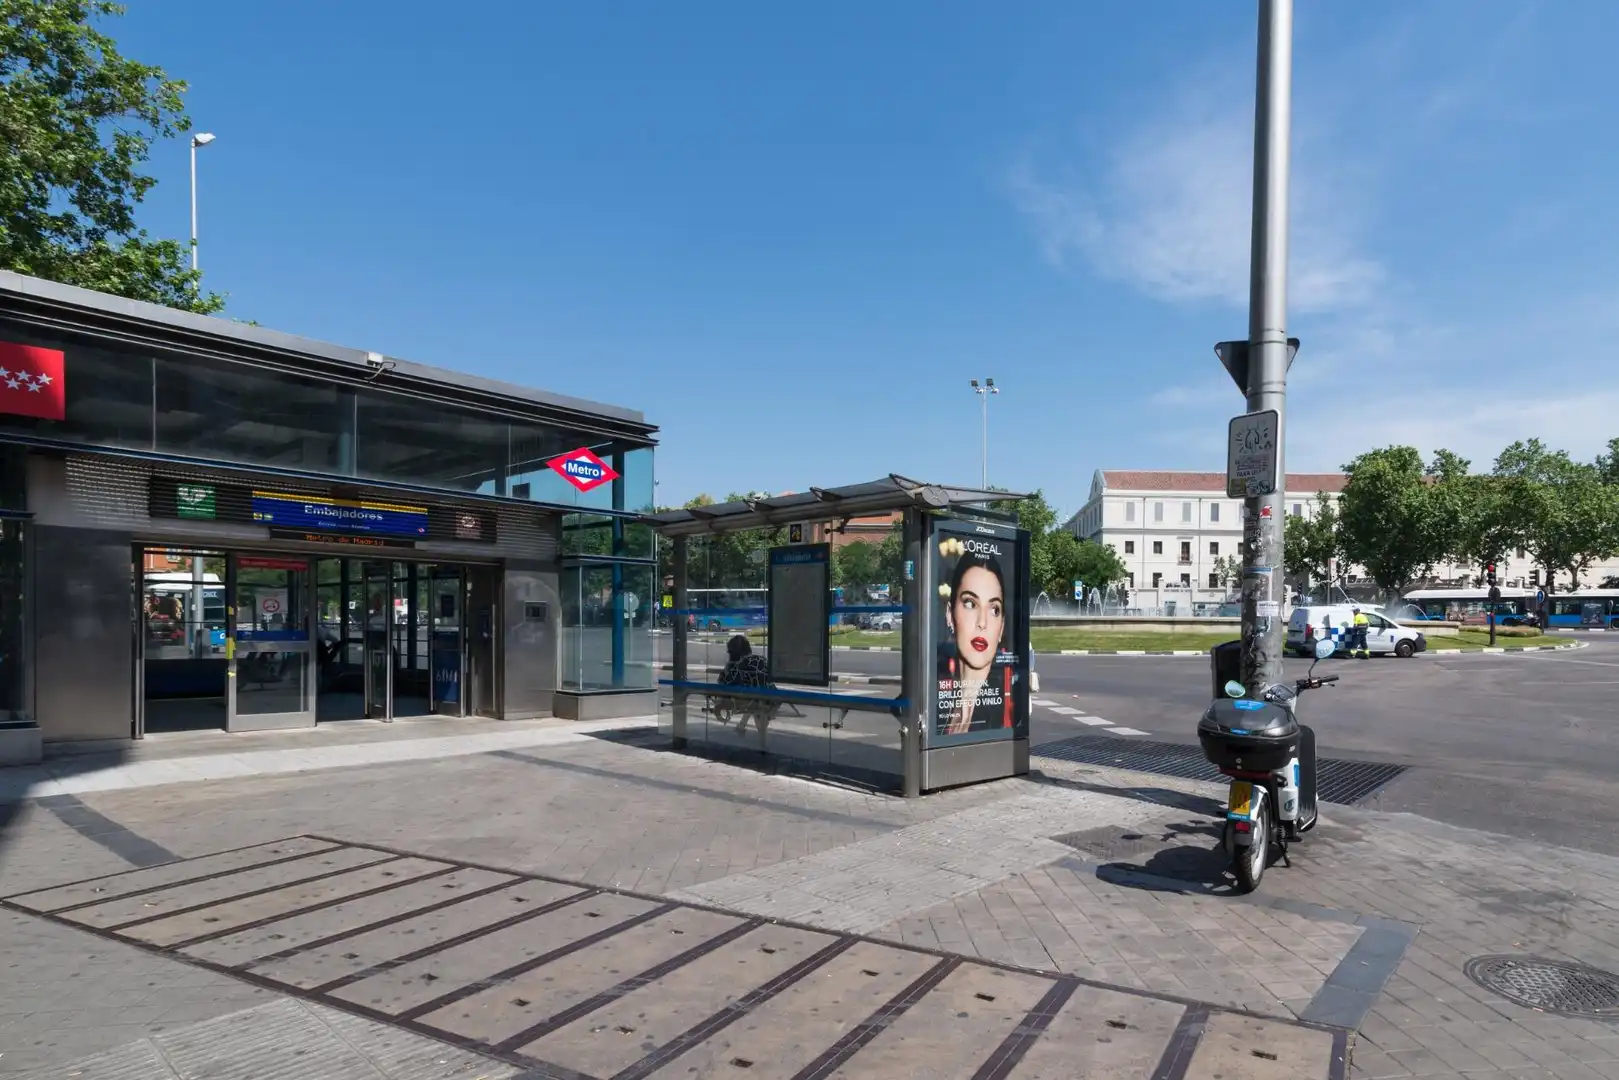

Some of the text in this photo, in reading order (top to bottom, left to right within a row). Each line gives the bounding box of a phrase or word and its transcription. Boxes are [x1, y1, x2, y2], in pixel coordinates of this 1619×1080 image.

[567, 462, 600, 477] Metro
[305, 505, 383, 520] Embajadores
[306, 534, 334, 543] Metro
[353, 537, 384, 546] Madrid
[962, 540, 1002, 555] L'ORÉAL
[975, 553, 991, 561] PARIS
[938, 680, 952, 690] 16H
[938, 687, 1000, 700] BRILLO ARABLE
[938, 696, 1003, 709] CON EFECO VINILO
